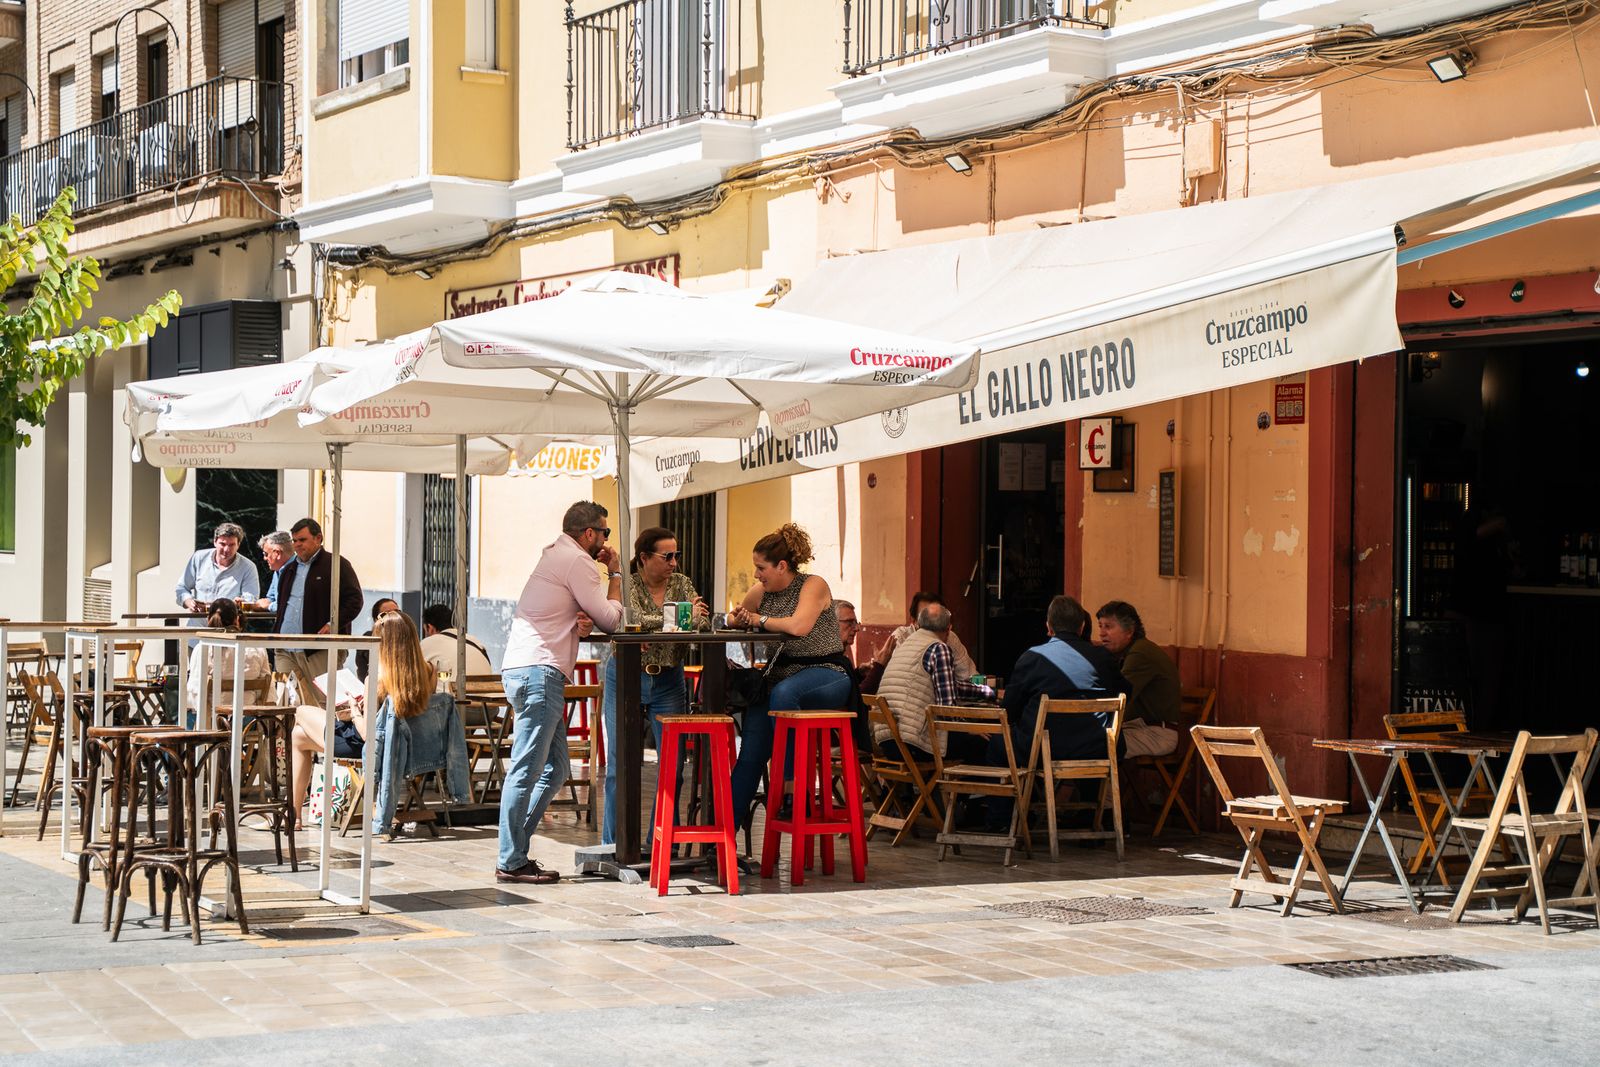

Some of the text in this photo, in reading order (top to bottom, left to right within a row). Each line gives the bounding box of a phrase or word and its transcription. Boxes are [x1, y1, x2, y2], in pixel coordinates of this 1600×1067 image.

[1205, 304, 1308, 346] Cruzcampo
[850, 347, 953, 372] Cruzcampo
[1222, 337, 1293, 368] ESPECIAL
[1277, 385, 1303, 396] Alarma
[740, 425, 839, 471] CERVECERIAS
[959, 389, 981, 424] EL
[987, 358, 1053, 418] GALLO
[1060, 337, 1136, 403] NEGRO
[655, 450, 700, 472] Cruzcampo
[662, 471, 695, 488] ESPECIAL
